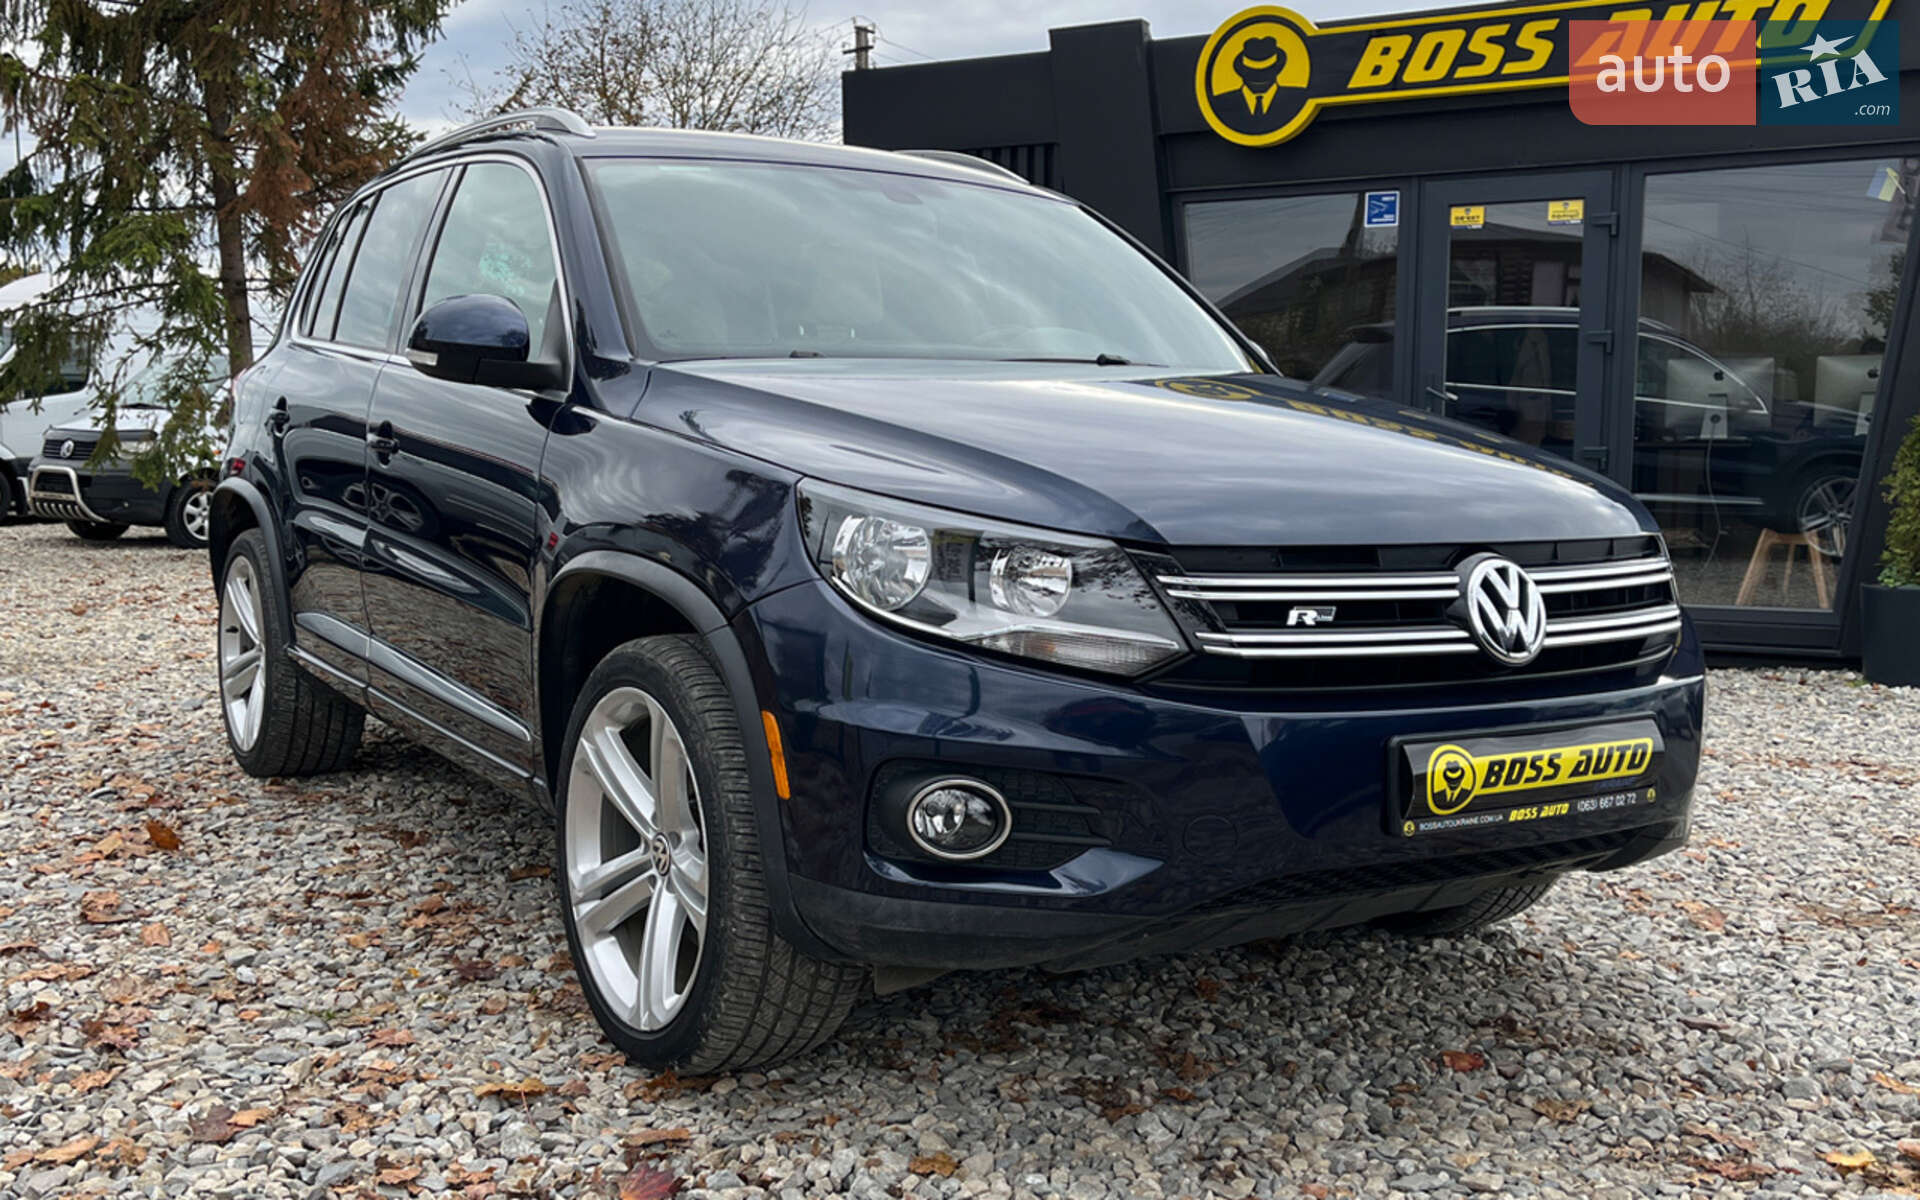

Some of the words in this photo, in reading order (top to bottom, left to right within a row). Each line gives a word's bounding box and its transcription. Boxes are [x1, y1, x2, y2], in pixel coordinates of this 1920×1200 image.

[1347, 18, 1560, 89] BOSS
[1575, 0, 1824, 66] AUTO
[1480, 752, 1562, 789] BOSS
[1568, 743, 1649, 778] AUTO
[1508, 806, 1538, 822] BOSS
[1540, 802, 1570, 818] AUTO
[1627, 792, 1637, 804] 72
